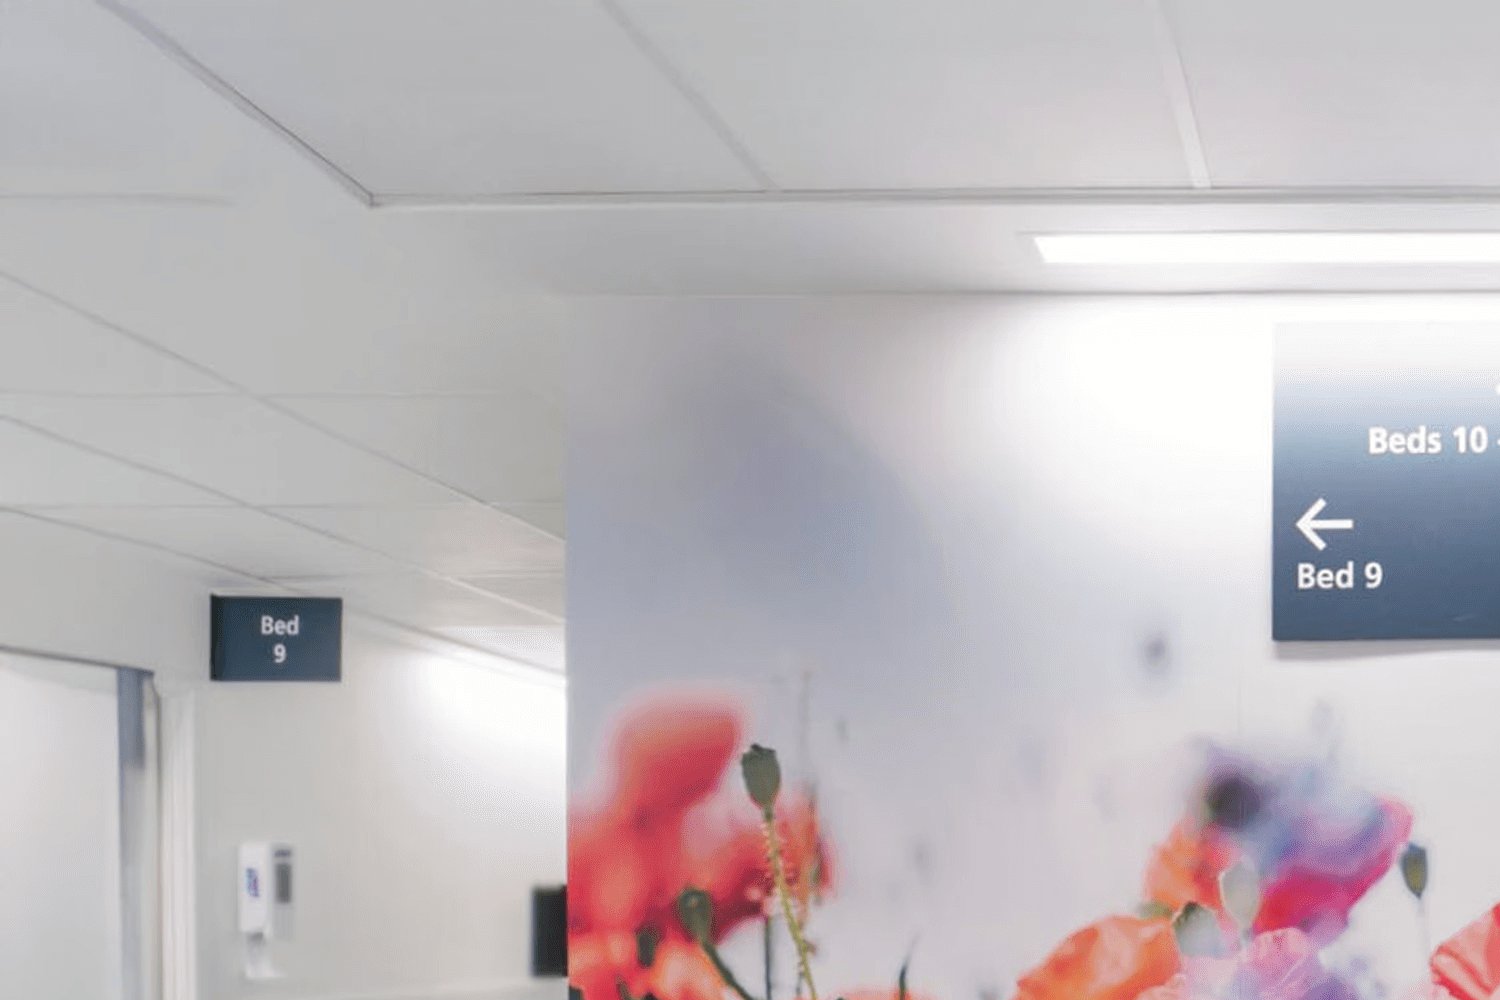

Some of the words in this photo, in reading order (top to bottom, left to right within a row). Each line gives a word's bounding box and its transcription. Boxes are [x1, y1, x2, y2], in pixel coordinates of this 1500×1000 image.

[1368, 426, 1442, 454] Beds
[1453, 426, 1488, 454] 10
[1297, 561, 1354, 589] Bed
[1364, 562, 1383, 589] 9
[260, 615, 300, 635] Bed
[273, 643, 287, 663] 9
